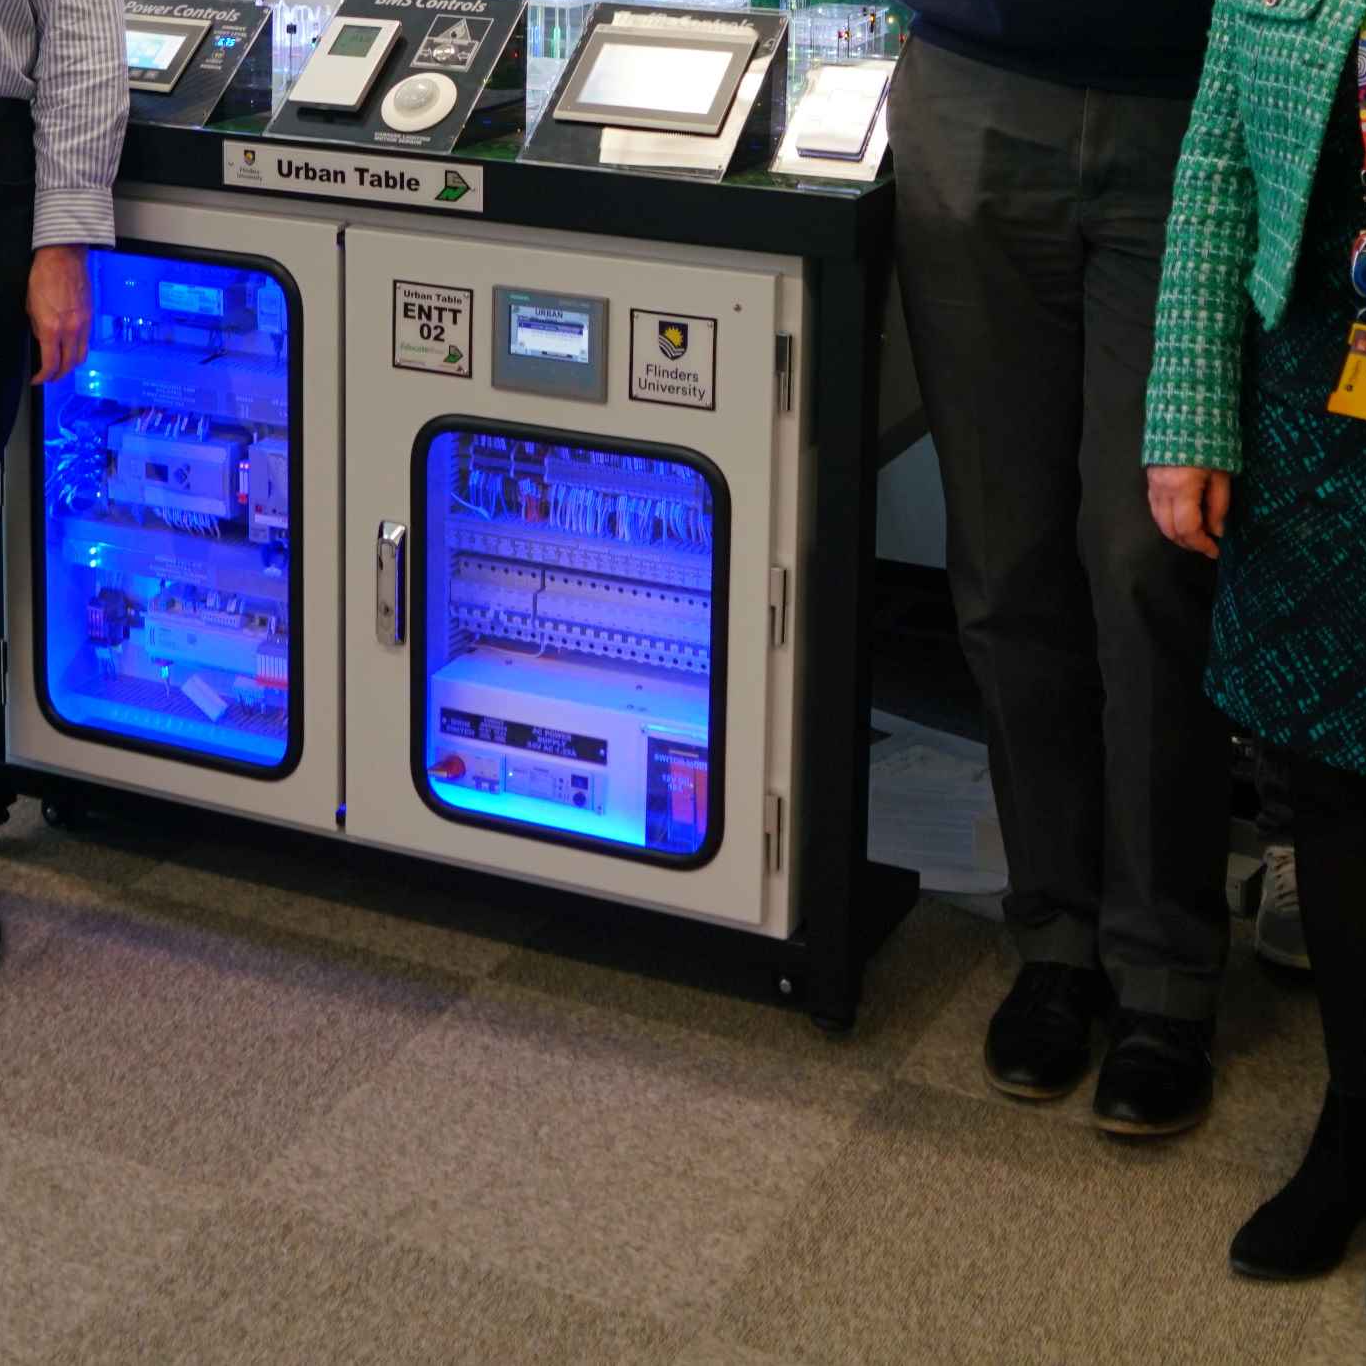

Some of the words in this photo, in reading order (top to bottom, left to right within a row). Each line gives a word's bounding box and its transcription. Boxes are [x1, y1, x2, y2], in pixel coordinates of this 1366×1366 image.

[124, 0, 174, 16] Power
[173, 4, 242, 23] Controls
[277, 158, 346, 185] Urban
[354, 166, 421, 192] Table
[403, 289, 433, 302] Urban
[435, 293, 463, 305] Table
[402, 302, 463, 326] ENTT
[419, 323, 446, 343] 02
[645, 363, 699, 383] Flinders
[638, 377, 706, 402] University
